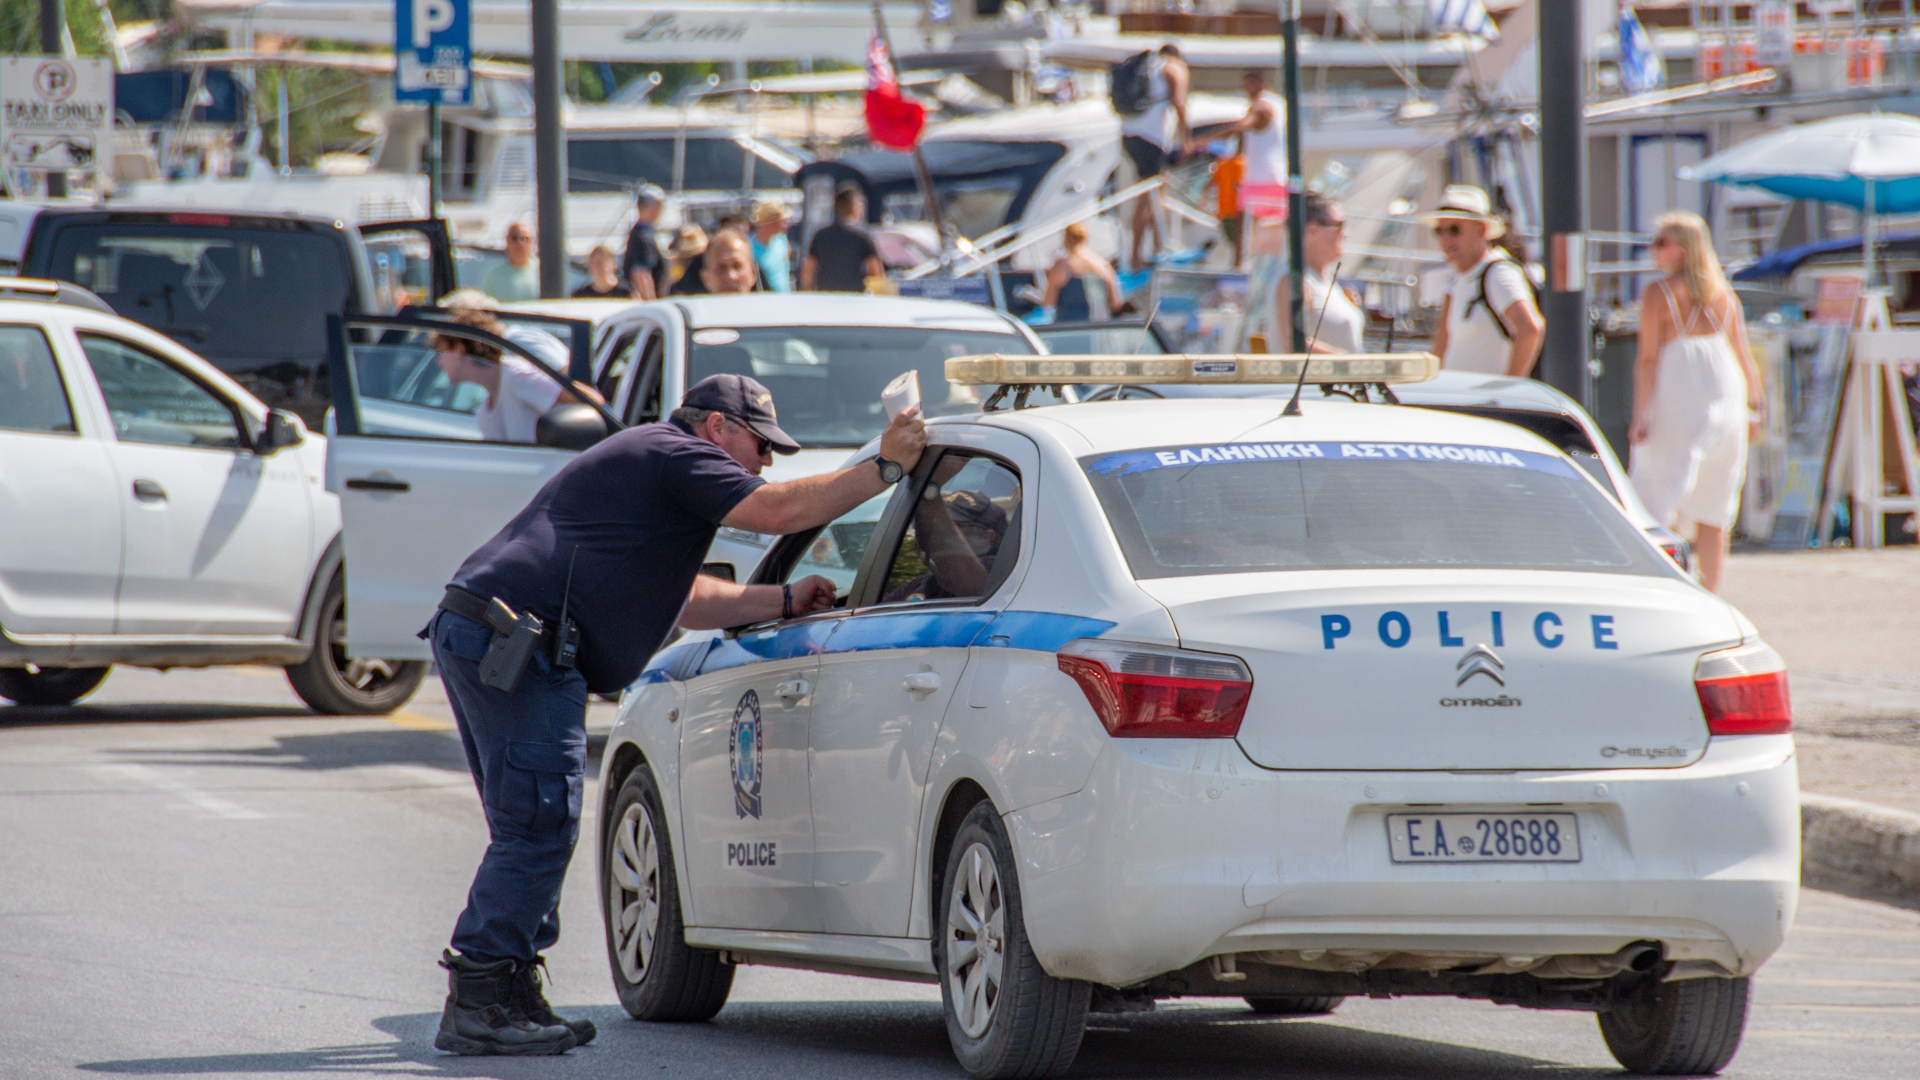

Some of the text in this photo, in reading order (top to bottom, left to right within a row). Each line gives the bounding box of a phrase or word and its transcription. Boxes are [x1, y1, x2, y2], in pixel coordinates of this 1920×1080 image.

[411, 0, 456, 48] P
[4, 101, 107, 121] TAXI ONLY
[1154, 443, 1527, 468] ΕΛΛΗΝΙΚΗ ΑΣΤΥΝΟΜΙΑ
[1321, 611, 1627, 650] POLICE
[1476, 819, 1562, 857] 28688
[728, 842, 776, 867] POLICE
